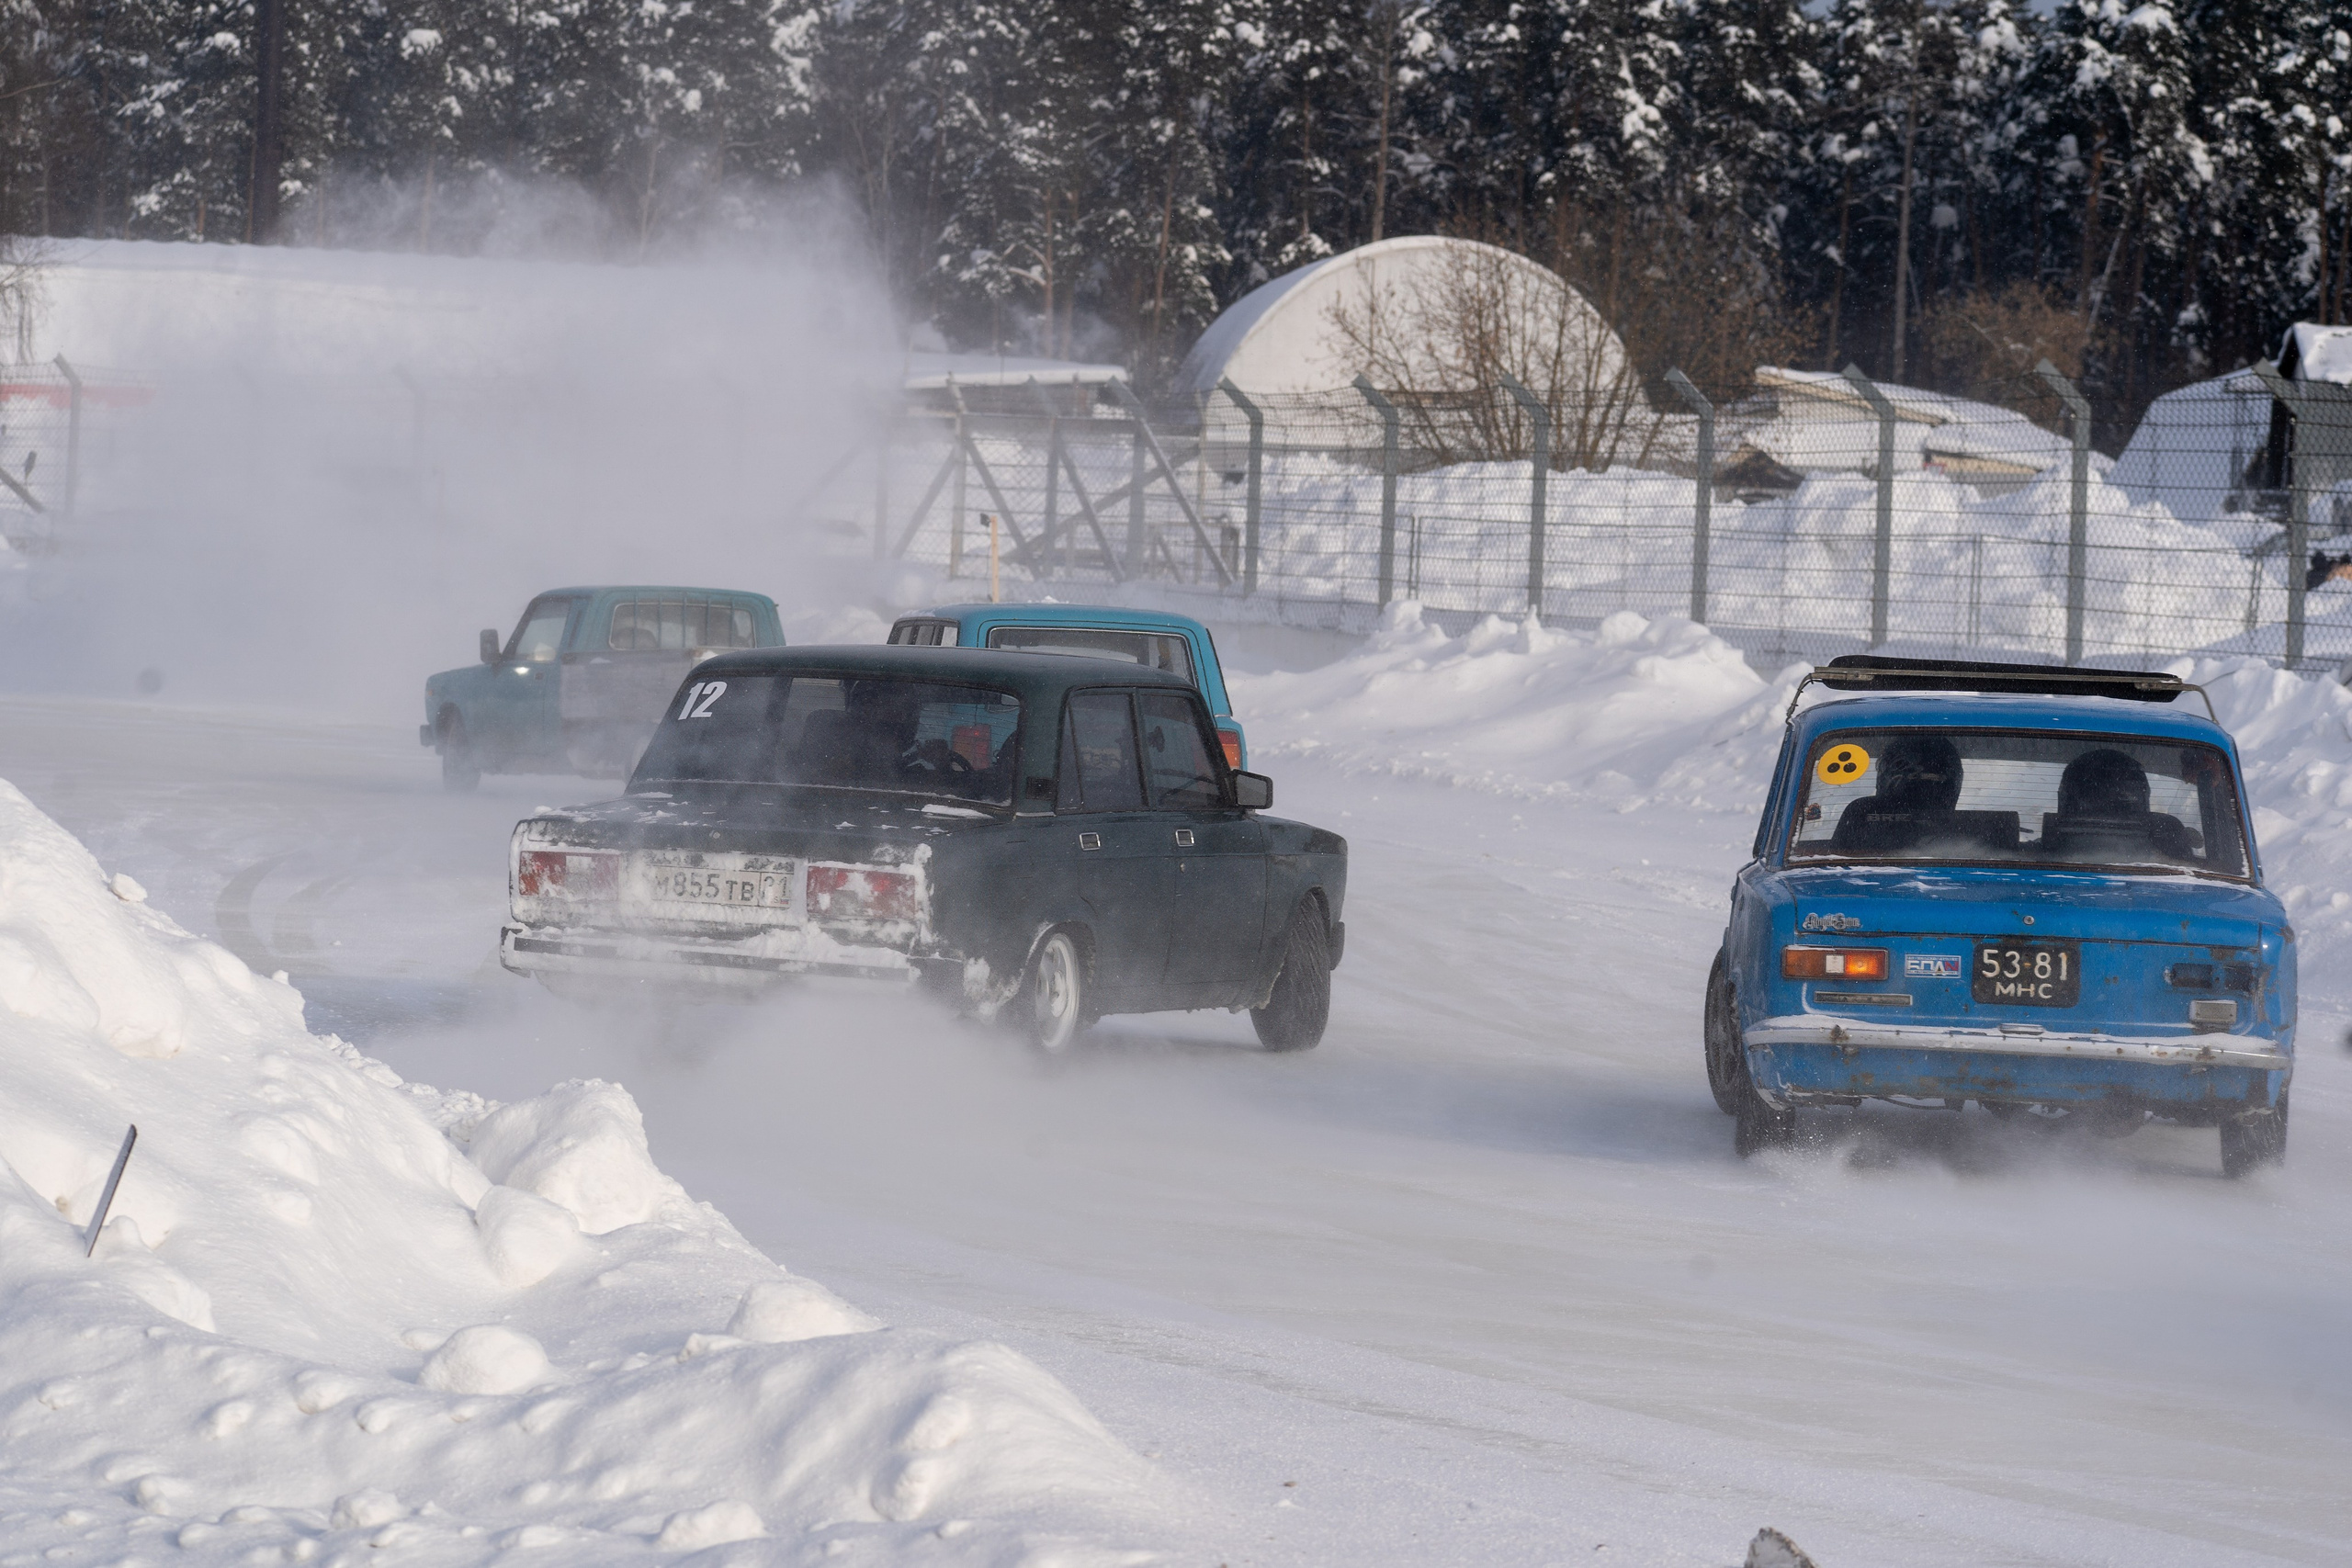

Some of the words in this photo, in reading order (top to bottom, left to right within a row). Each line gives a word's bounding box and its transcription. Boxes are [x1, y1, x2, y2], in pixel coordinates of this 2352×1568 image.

[677, 681, 728, 721] 12
[1982, 949, 2067, 981] 53-81
[1995, 981, 2052, 999] МНС
